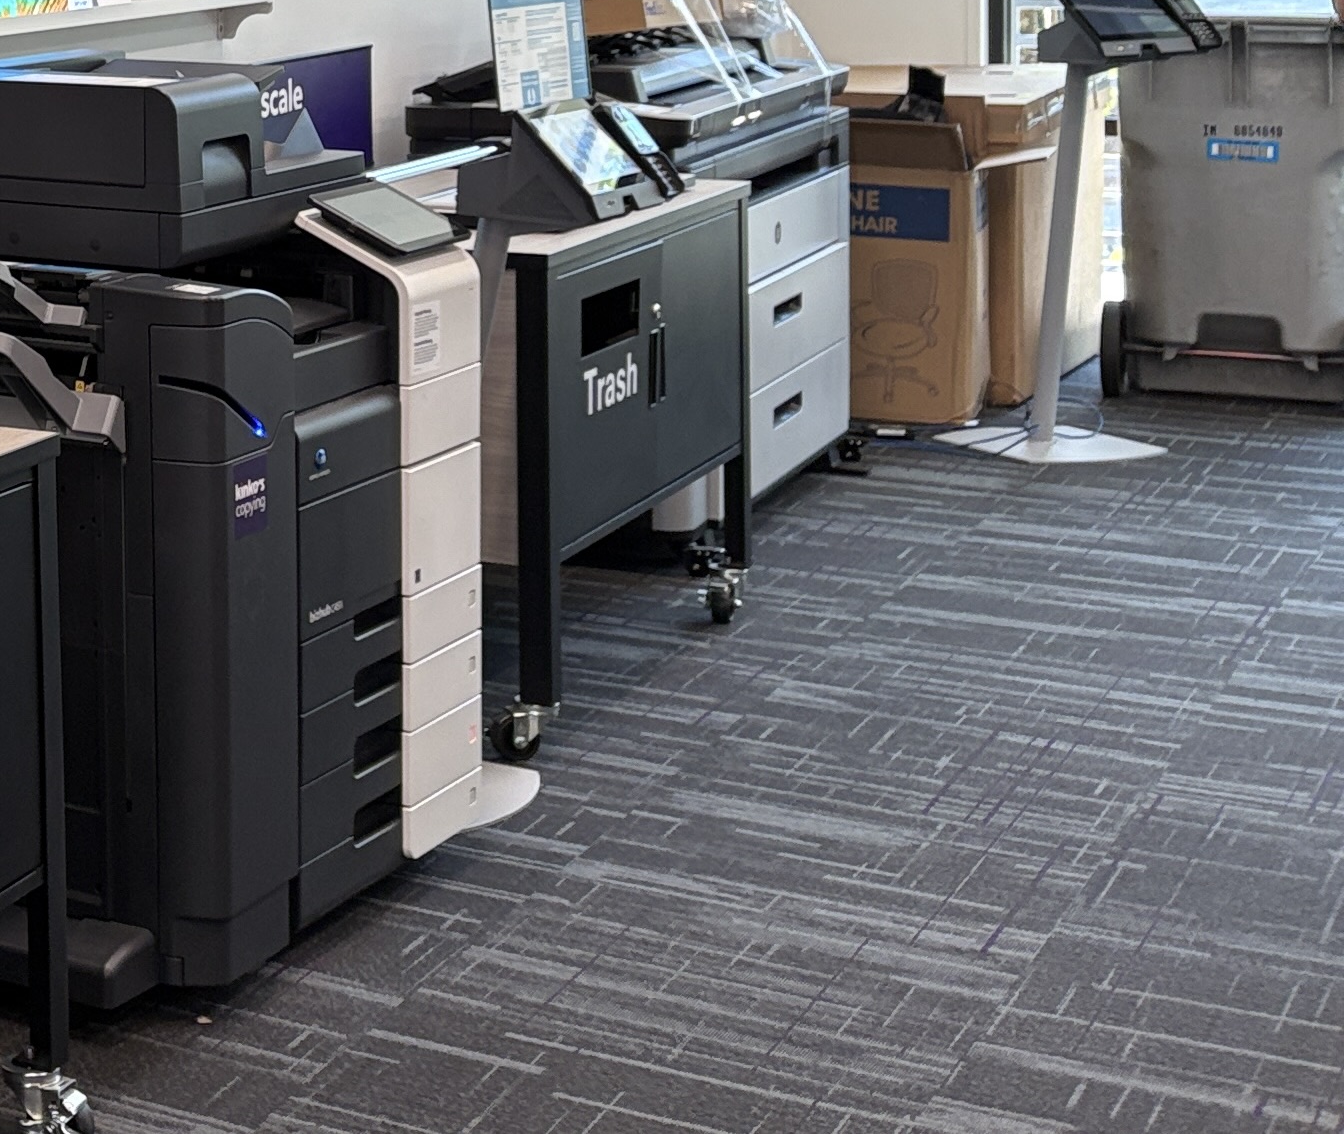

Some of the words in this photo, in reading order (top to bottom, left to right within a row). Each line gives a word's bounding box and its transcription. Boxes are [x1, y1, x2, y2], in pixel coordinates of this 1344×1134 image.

[260, 79, 305, 119] scale
[851, 215, 898, 235] HAIR
[583, 352, 638, 416] Trash
[234, 477, 265, 502] kinko's
[235, 494, 266, 517] copying
